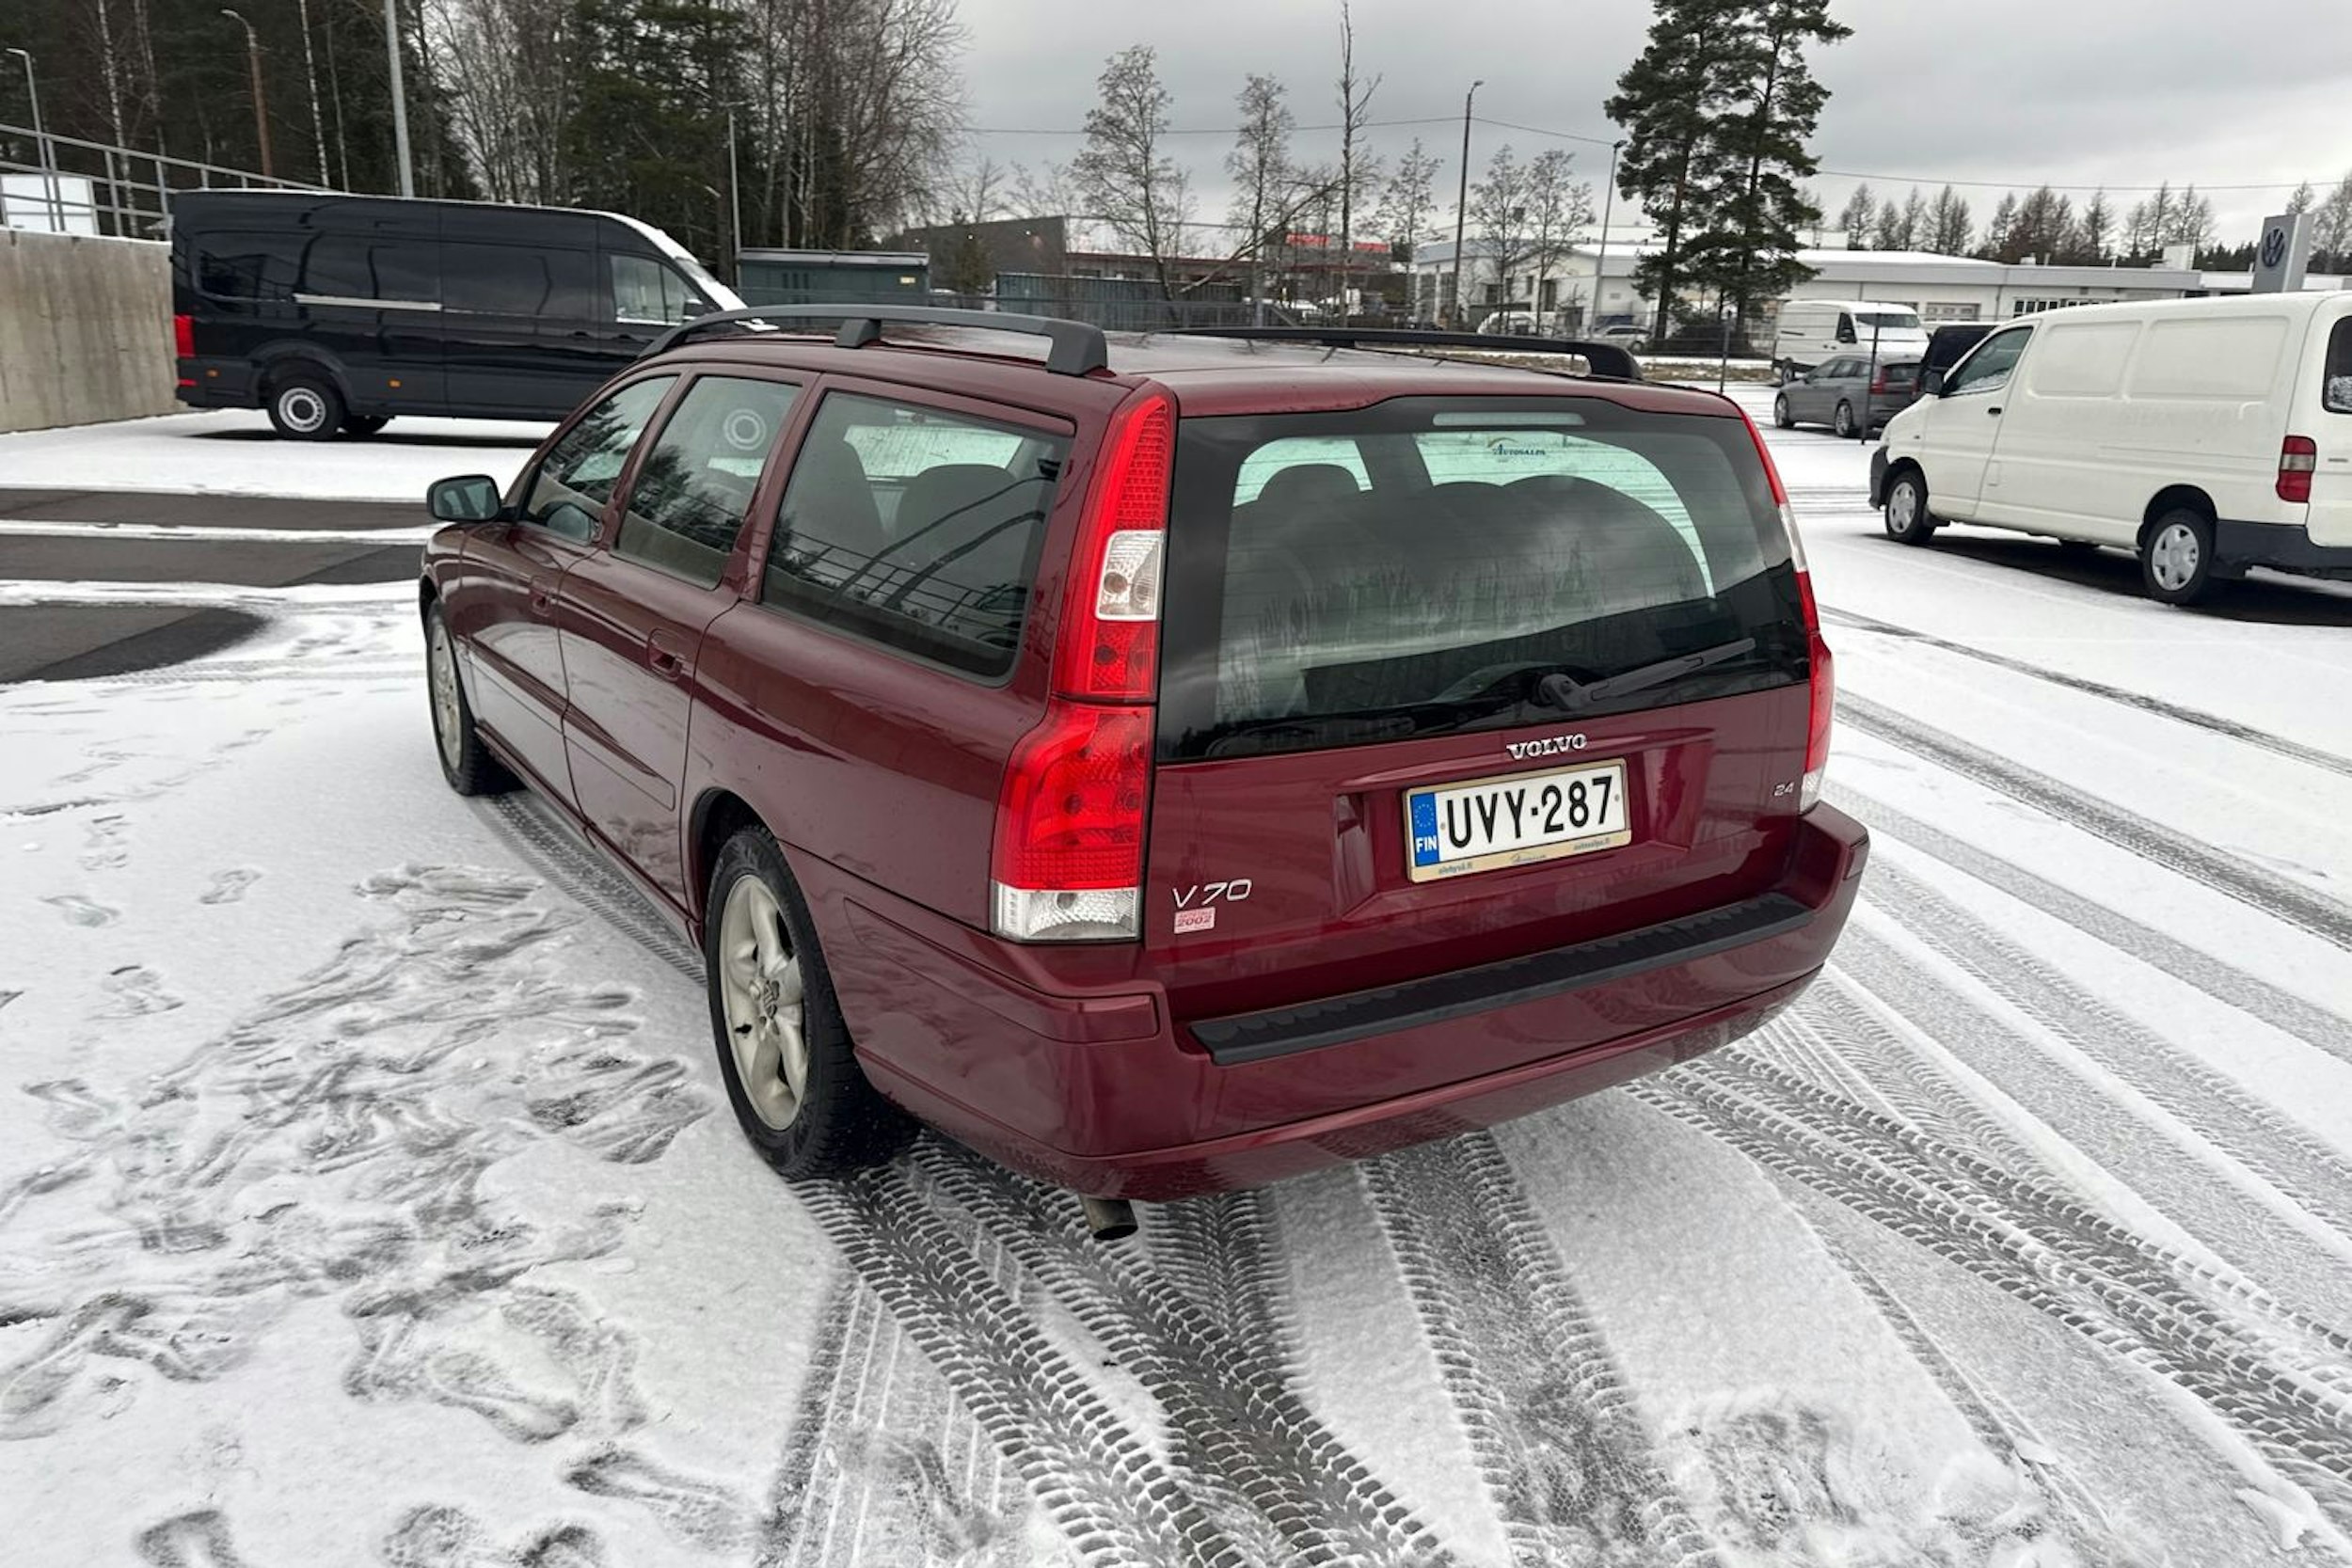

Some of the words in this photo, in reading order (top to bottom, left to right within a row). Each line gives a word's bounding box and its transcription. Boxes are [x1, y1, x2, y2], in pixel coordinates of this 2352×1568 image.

[1506, 734, 1588, 760] VOLVO
[1447, 775, 1613, 848] UVY-287
[1415, 835, 1438, 853] FIN
